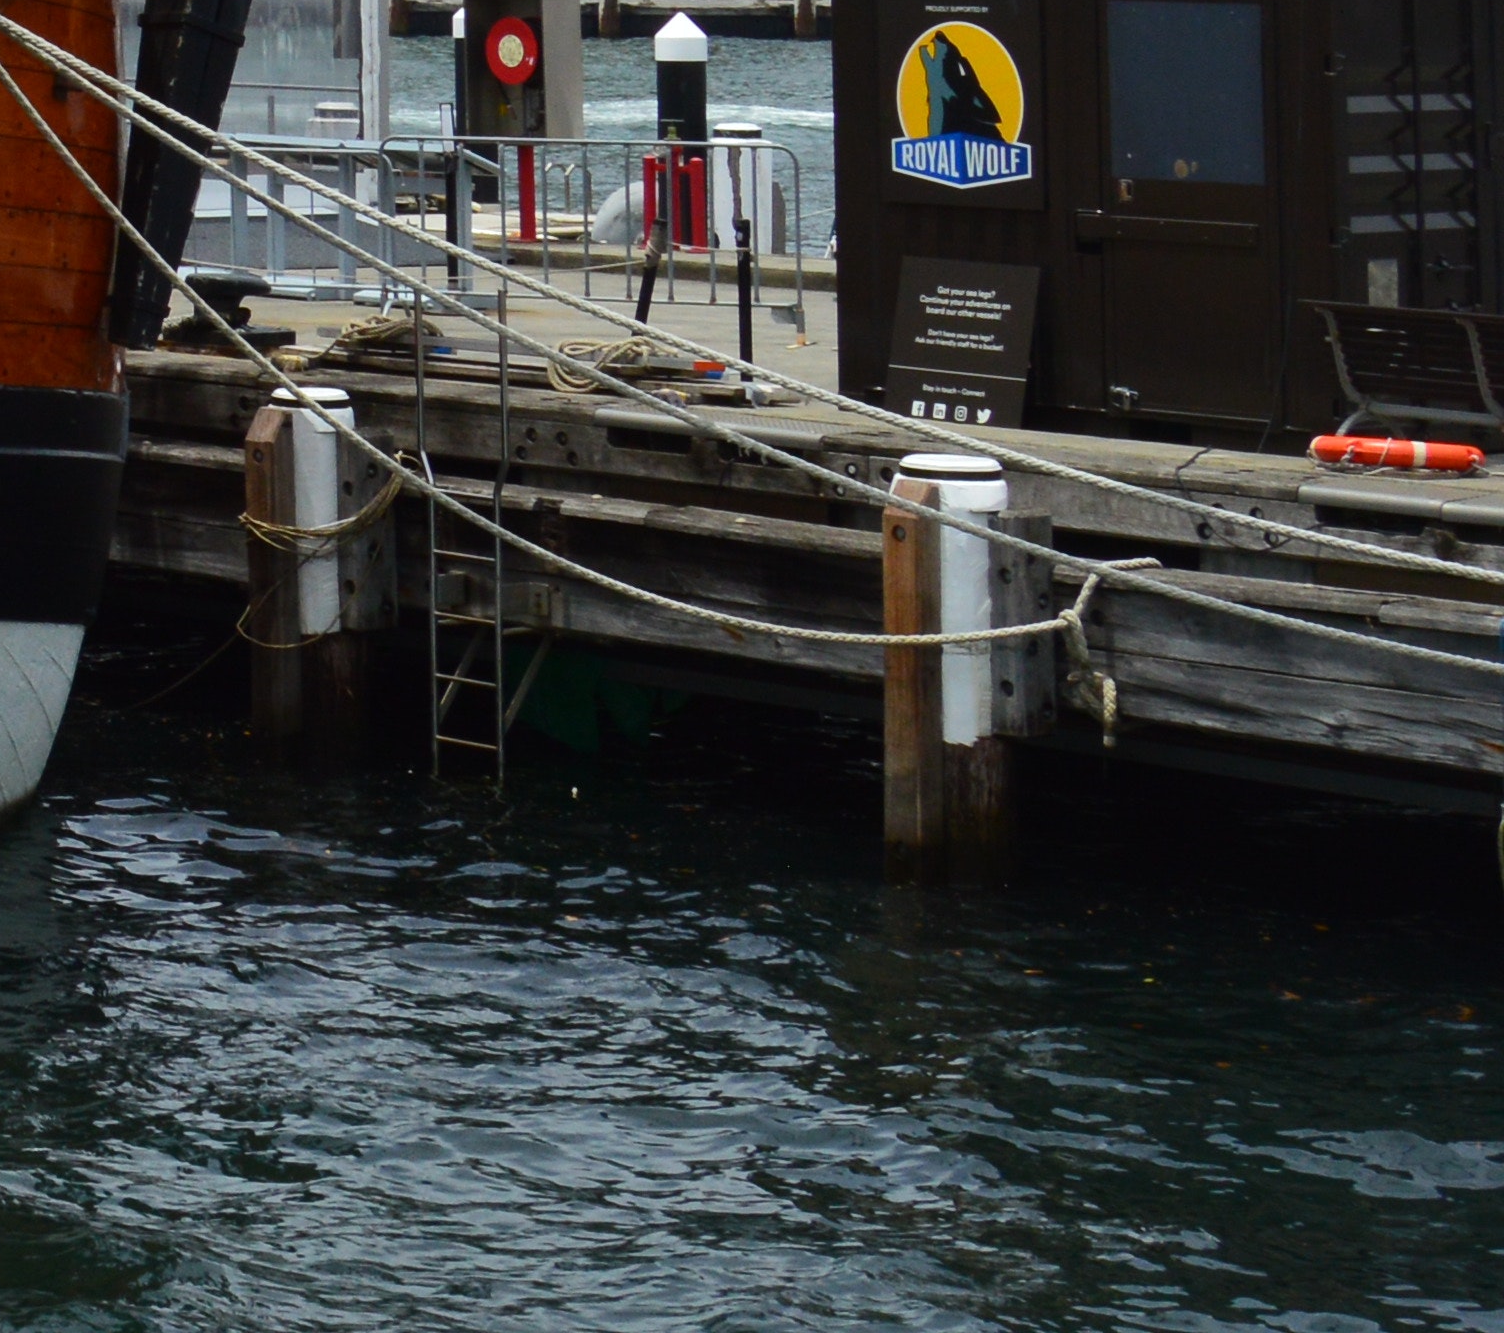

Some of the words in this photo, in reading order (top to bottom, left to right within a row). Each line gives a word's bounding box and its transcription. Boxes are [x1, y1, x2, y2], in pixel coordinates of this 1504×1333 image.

[902, 140, 960, 178] ROYAL
[965, 140, 1021, 178] WOLF
[937, 286, 949, 294] Got
[979, 290, 996, 300] legs?
[920, 294, 949, 305] Continue
[965, 300, 1001, 310] adventures
[926, 306, 945, 315] board
[957, 309, 975, 317] other
[976, 312, 1002, 320] vessels!
[943, 330, 956, 338] have
[979, 334, 994, 342] legs?
[936, 338, 956, 347] friendly
[983, 343, 1004, 352] bucket!
[922, 383, 934, 392] Stay
[962, 388, 986, 398] Connect
